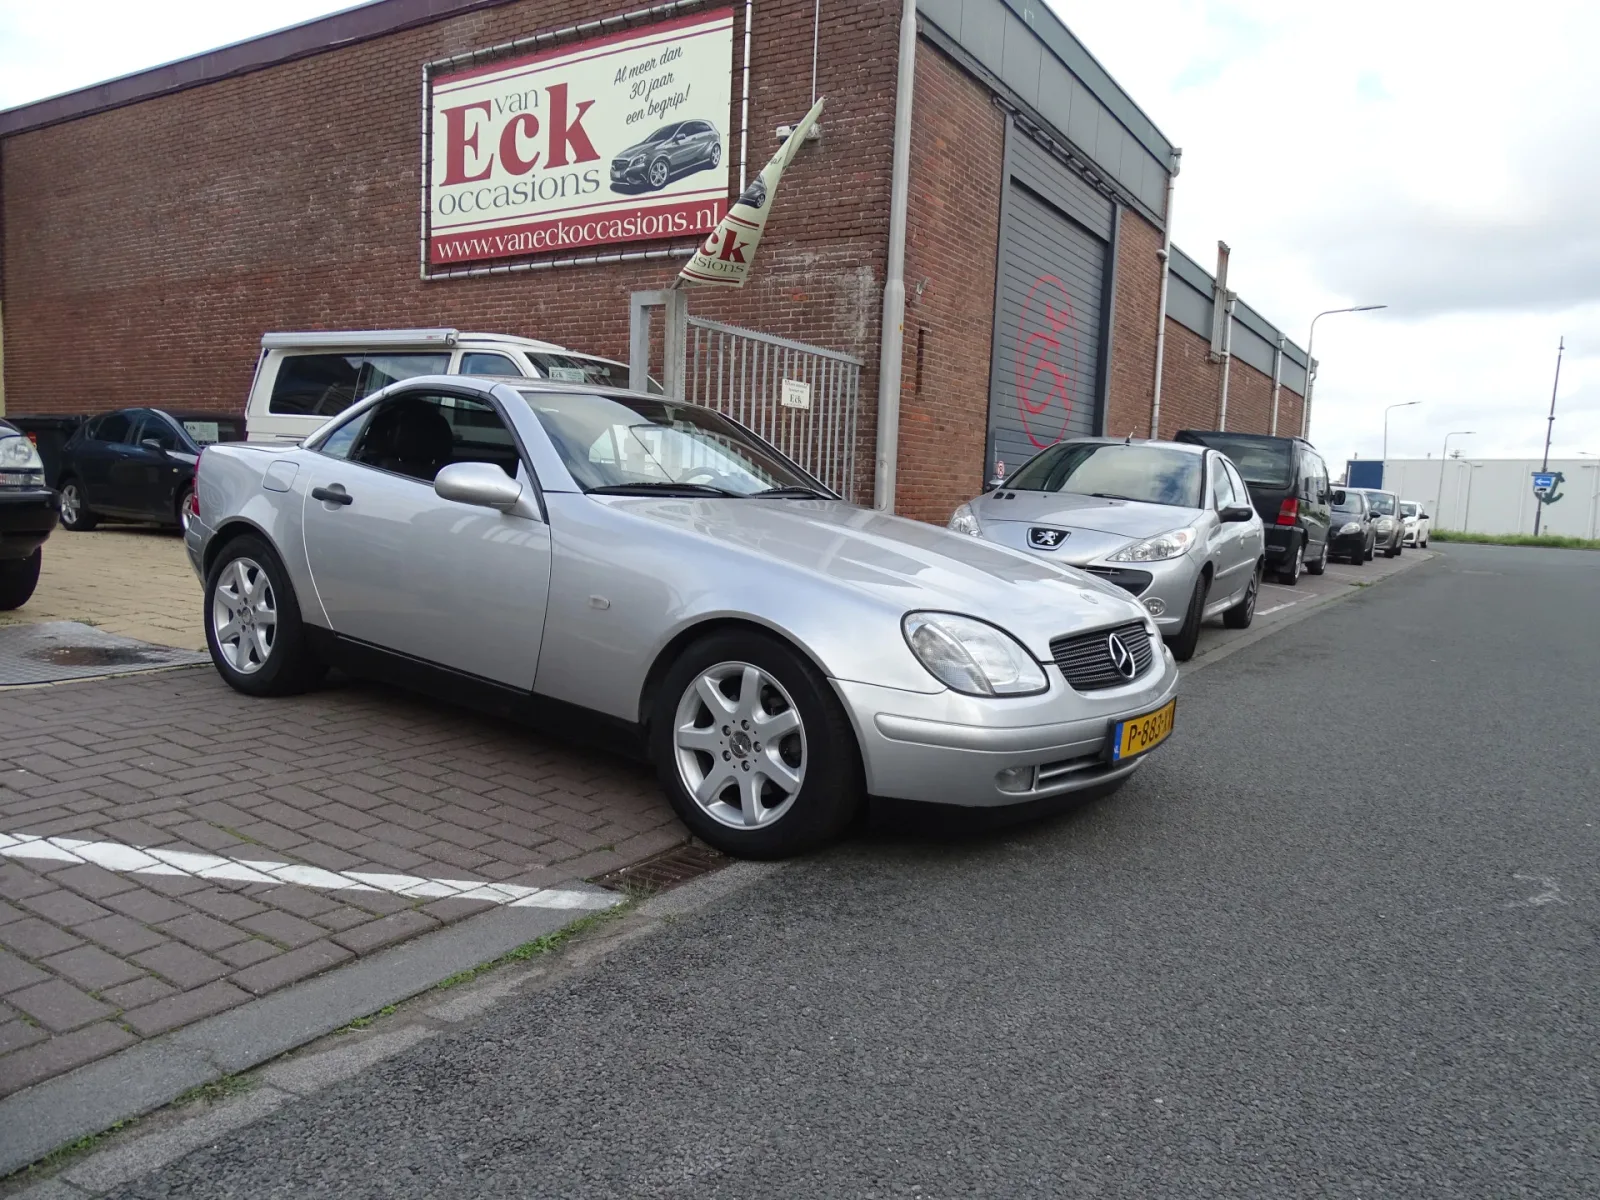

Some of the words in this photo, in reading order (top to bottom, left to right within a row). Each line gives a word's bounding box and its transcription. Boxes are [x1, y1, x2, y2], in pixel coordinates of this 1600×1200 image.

[614, 65, 627, 86] Al
[628, 57, 657, 79] meer
[660, 46, 683, 65] dan
[494, 89, 539, 114] van
[626, 108, 645, 125] een
[647, 83, 690, 120] begrip!
[629, 80, 646, 100] 30
[645, 72, 674, 102] jaar
[439, 82, 601, 187] Eck
[438, 169, 601, 216] occasions
[437, 202, 720, 258] www.vaneckoccasions.nl
[699, 227, 750, 264] ck
